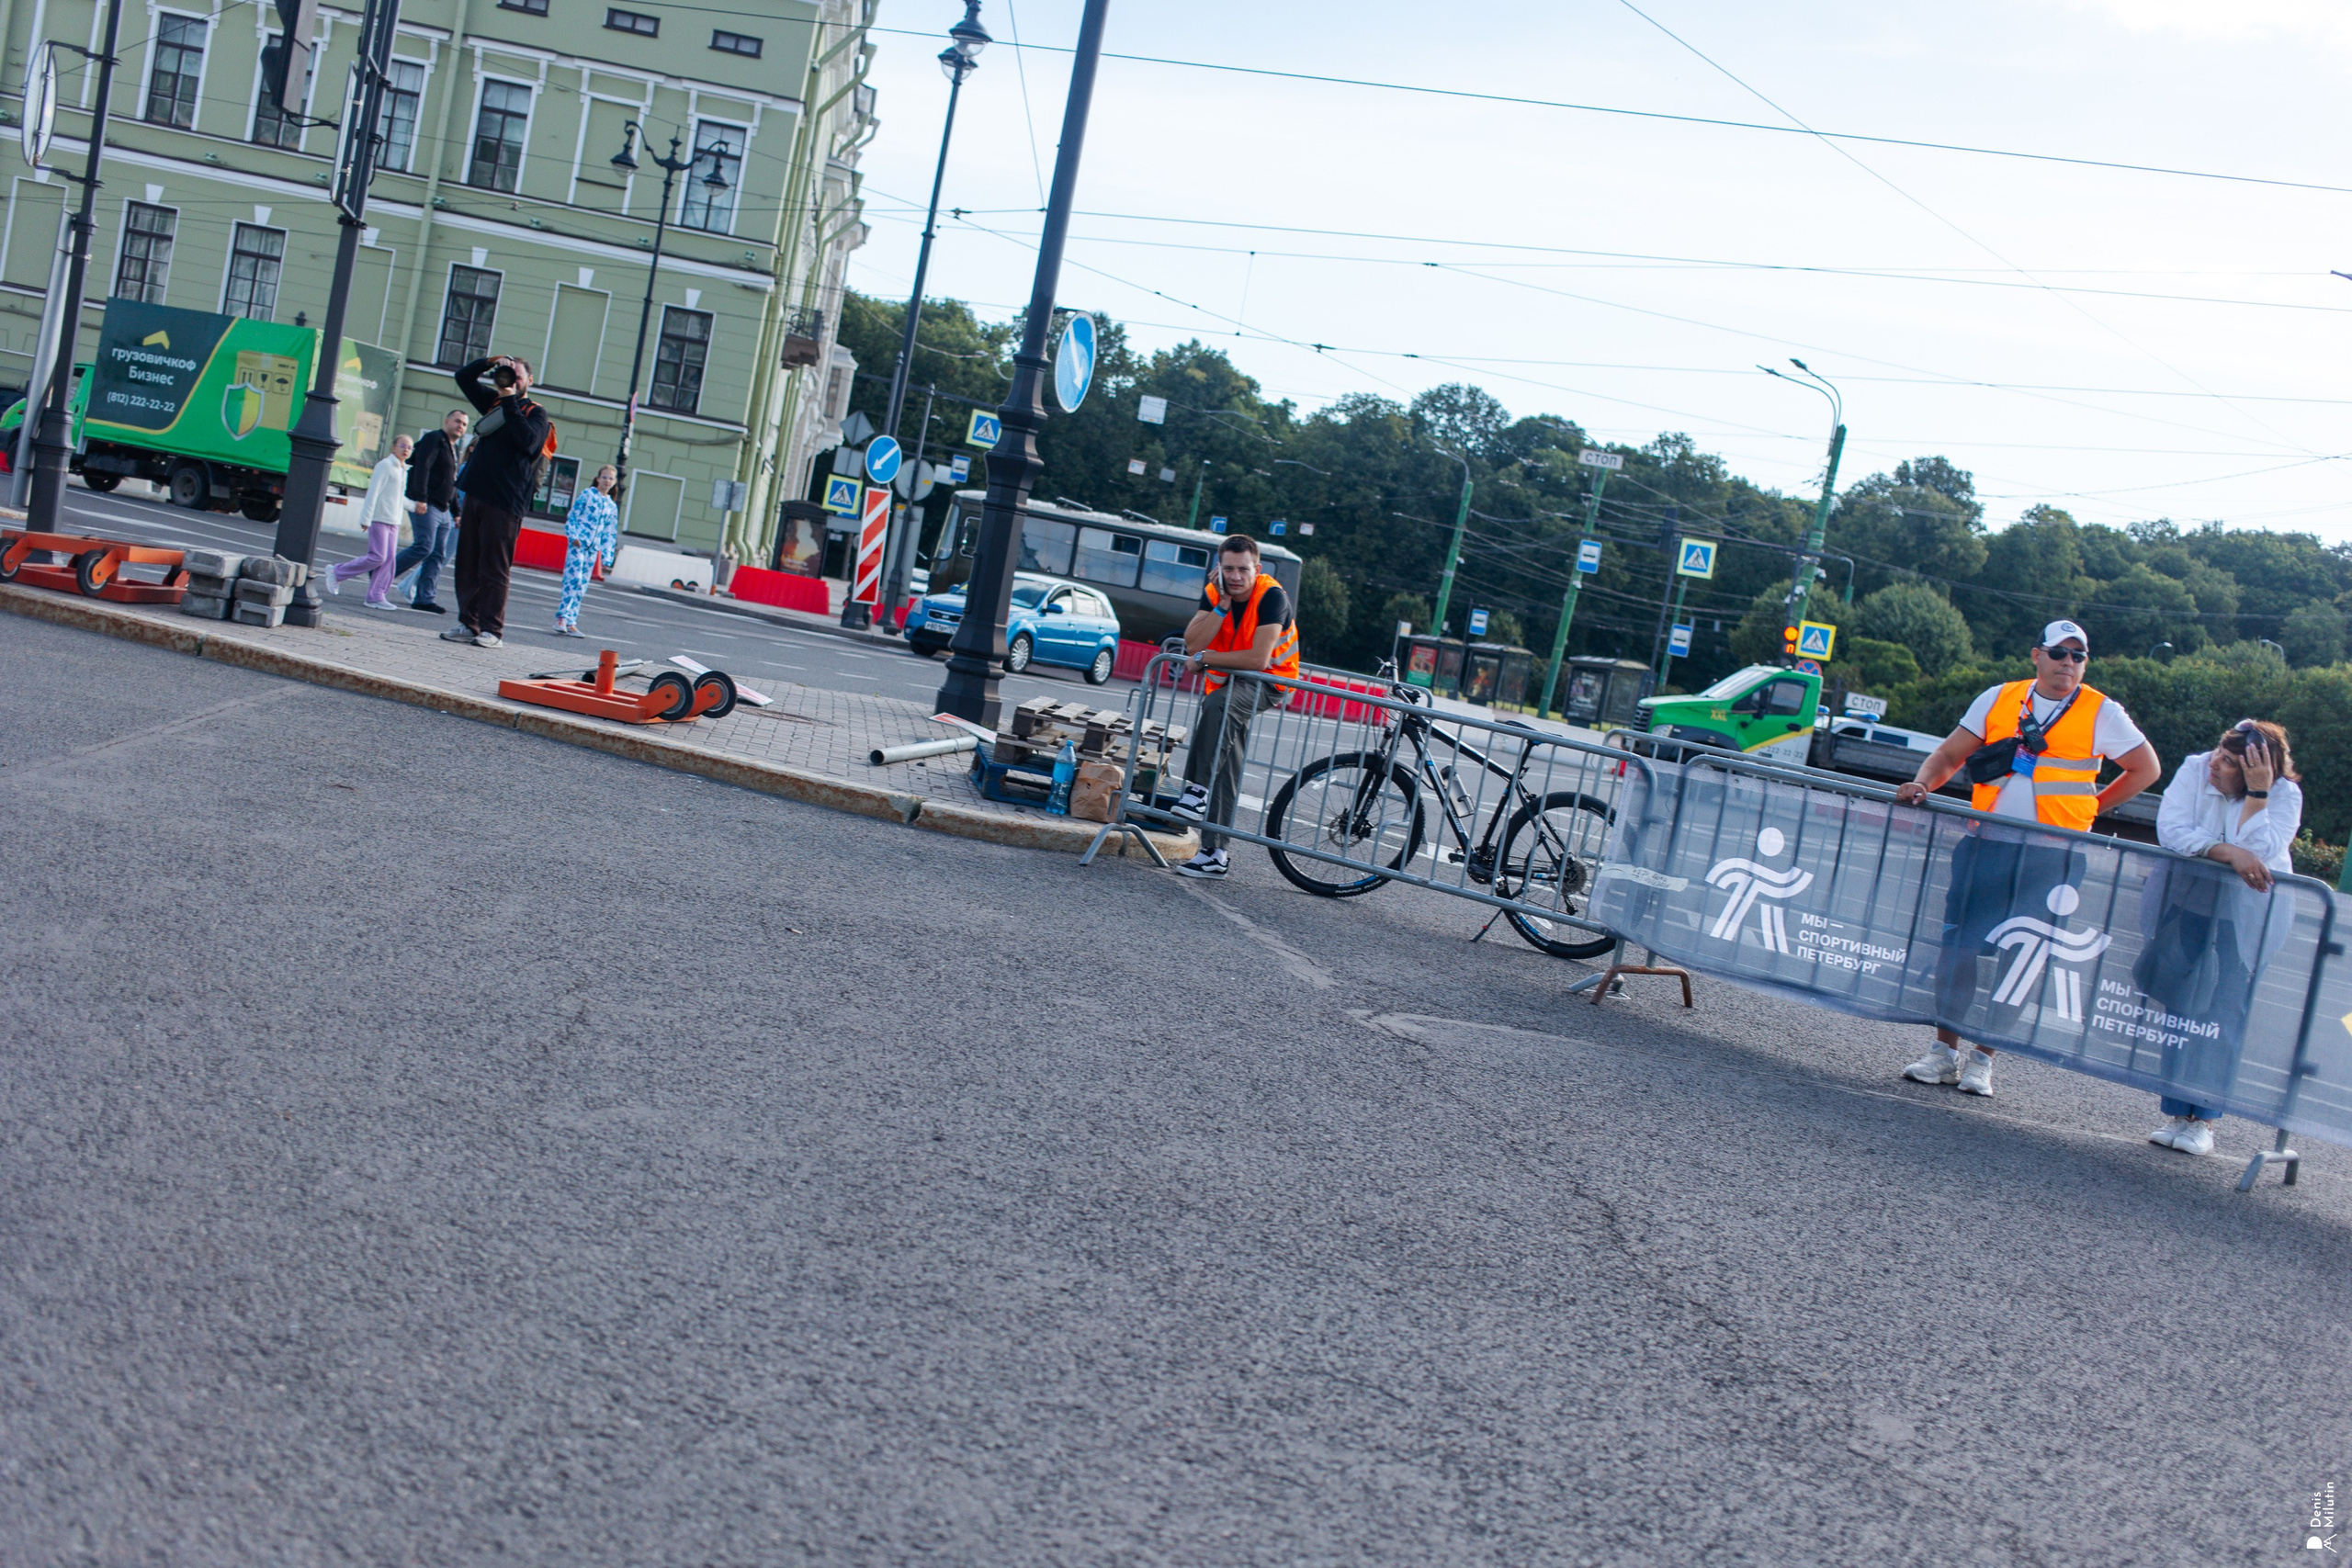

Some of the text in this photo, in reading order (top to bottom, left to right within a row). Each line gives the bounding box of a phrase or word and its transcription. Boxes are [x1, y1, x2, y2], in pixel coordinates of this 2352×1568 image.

[111, 347, 197, 372] грузовичкоф
[129, 366, 175, 386] Бизнес
[107, 391, 175, 412] (812) 222-22-22
[1586, 452, 1617, 467] СТОП
[1852, 696, 1881, 712] СТОП
[1801, 912, 1828, 929] МЫ
[1798, 930, 1907, 964] СПОРТИВНЫЙ
[1796, 945, 1882, 975] ПЕТЕРБУРГ
[2100, 978, 2131, 998] МЫ
[2096, 997, 2221, 1040] СПОРТИВНЫЙ
[2091, 1014, 2189, 1049] ПЕТЕРБУРГ
